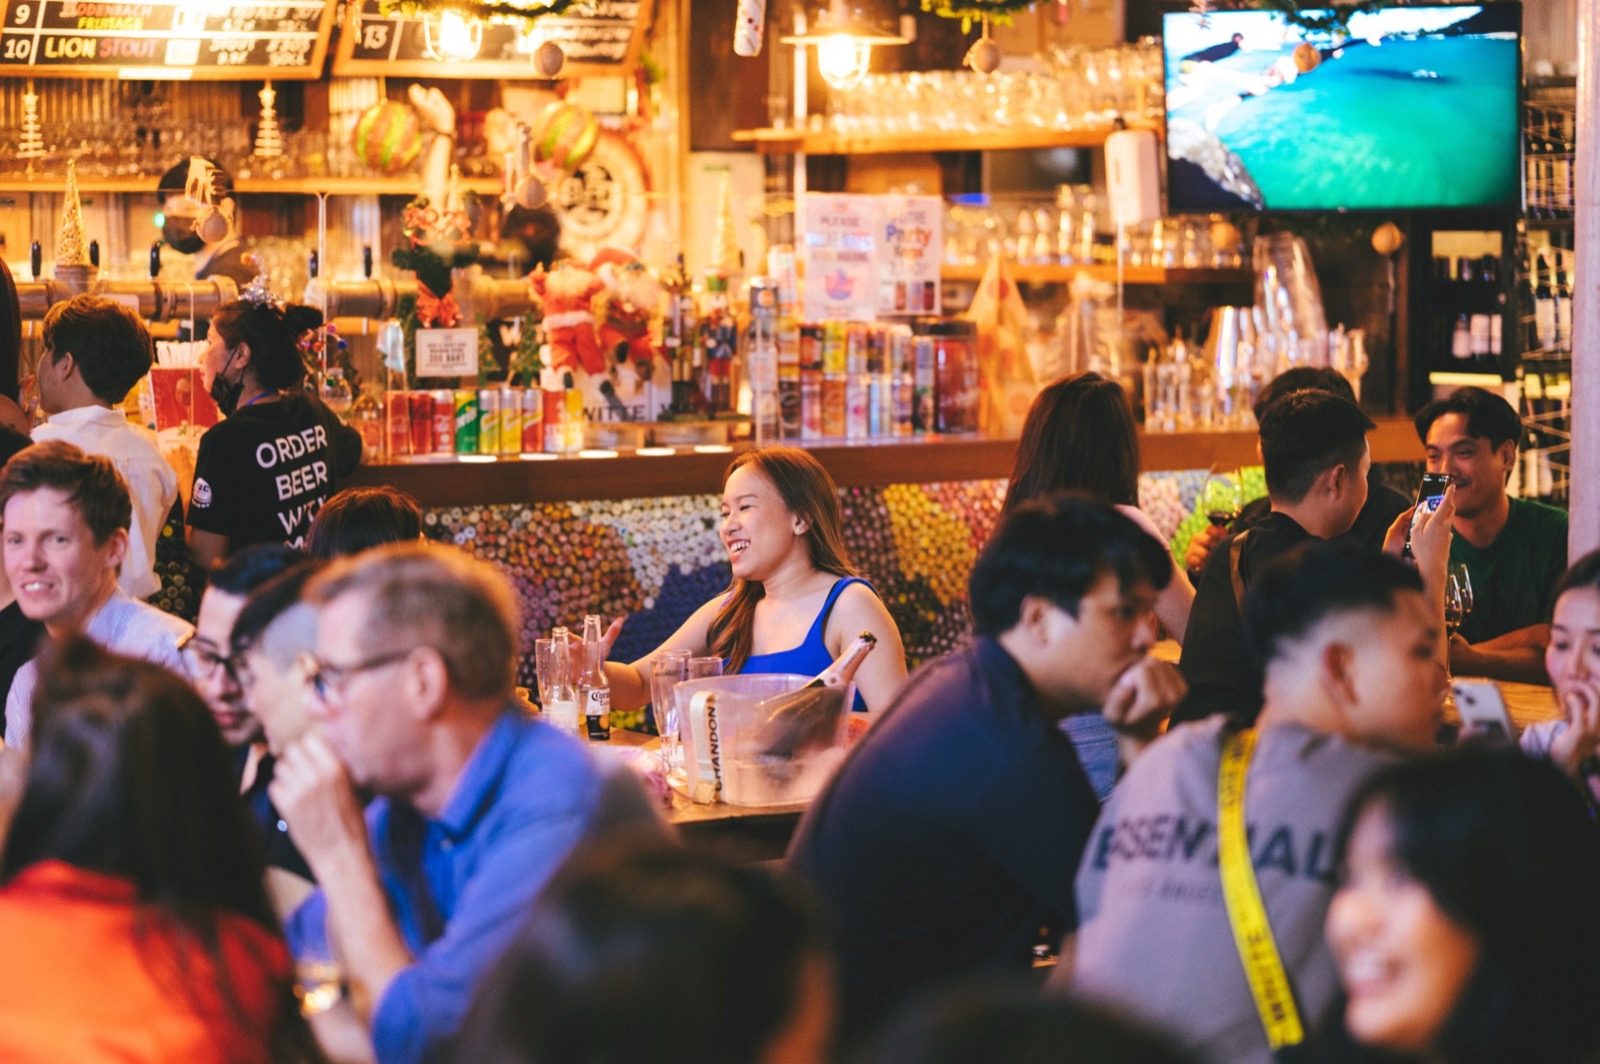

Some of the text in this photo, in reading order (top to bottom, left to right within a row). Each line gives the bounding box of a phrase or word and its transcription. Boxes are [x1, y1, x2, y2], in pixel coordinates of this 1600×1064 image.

[14, 4, 31, 25] 9
[3, 39, 31, 59] 10
[44, 37, 158, 59] LION STOUT
[363, 25, 389, 49] 13
[255, 424, 329, 470] ORDER
[275, 460, 329, 501] BEER
[707, 705, 723, 792] CHANDON
